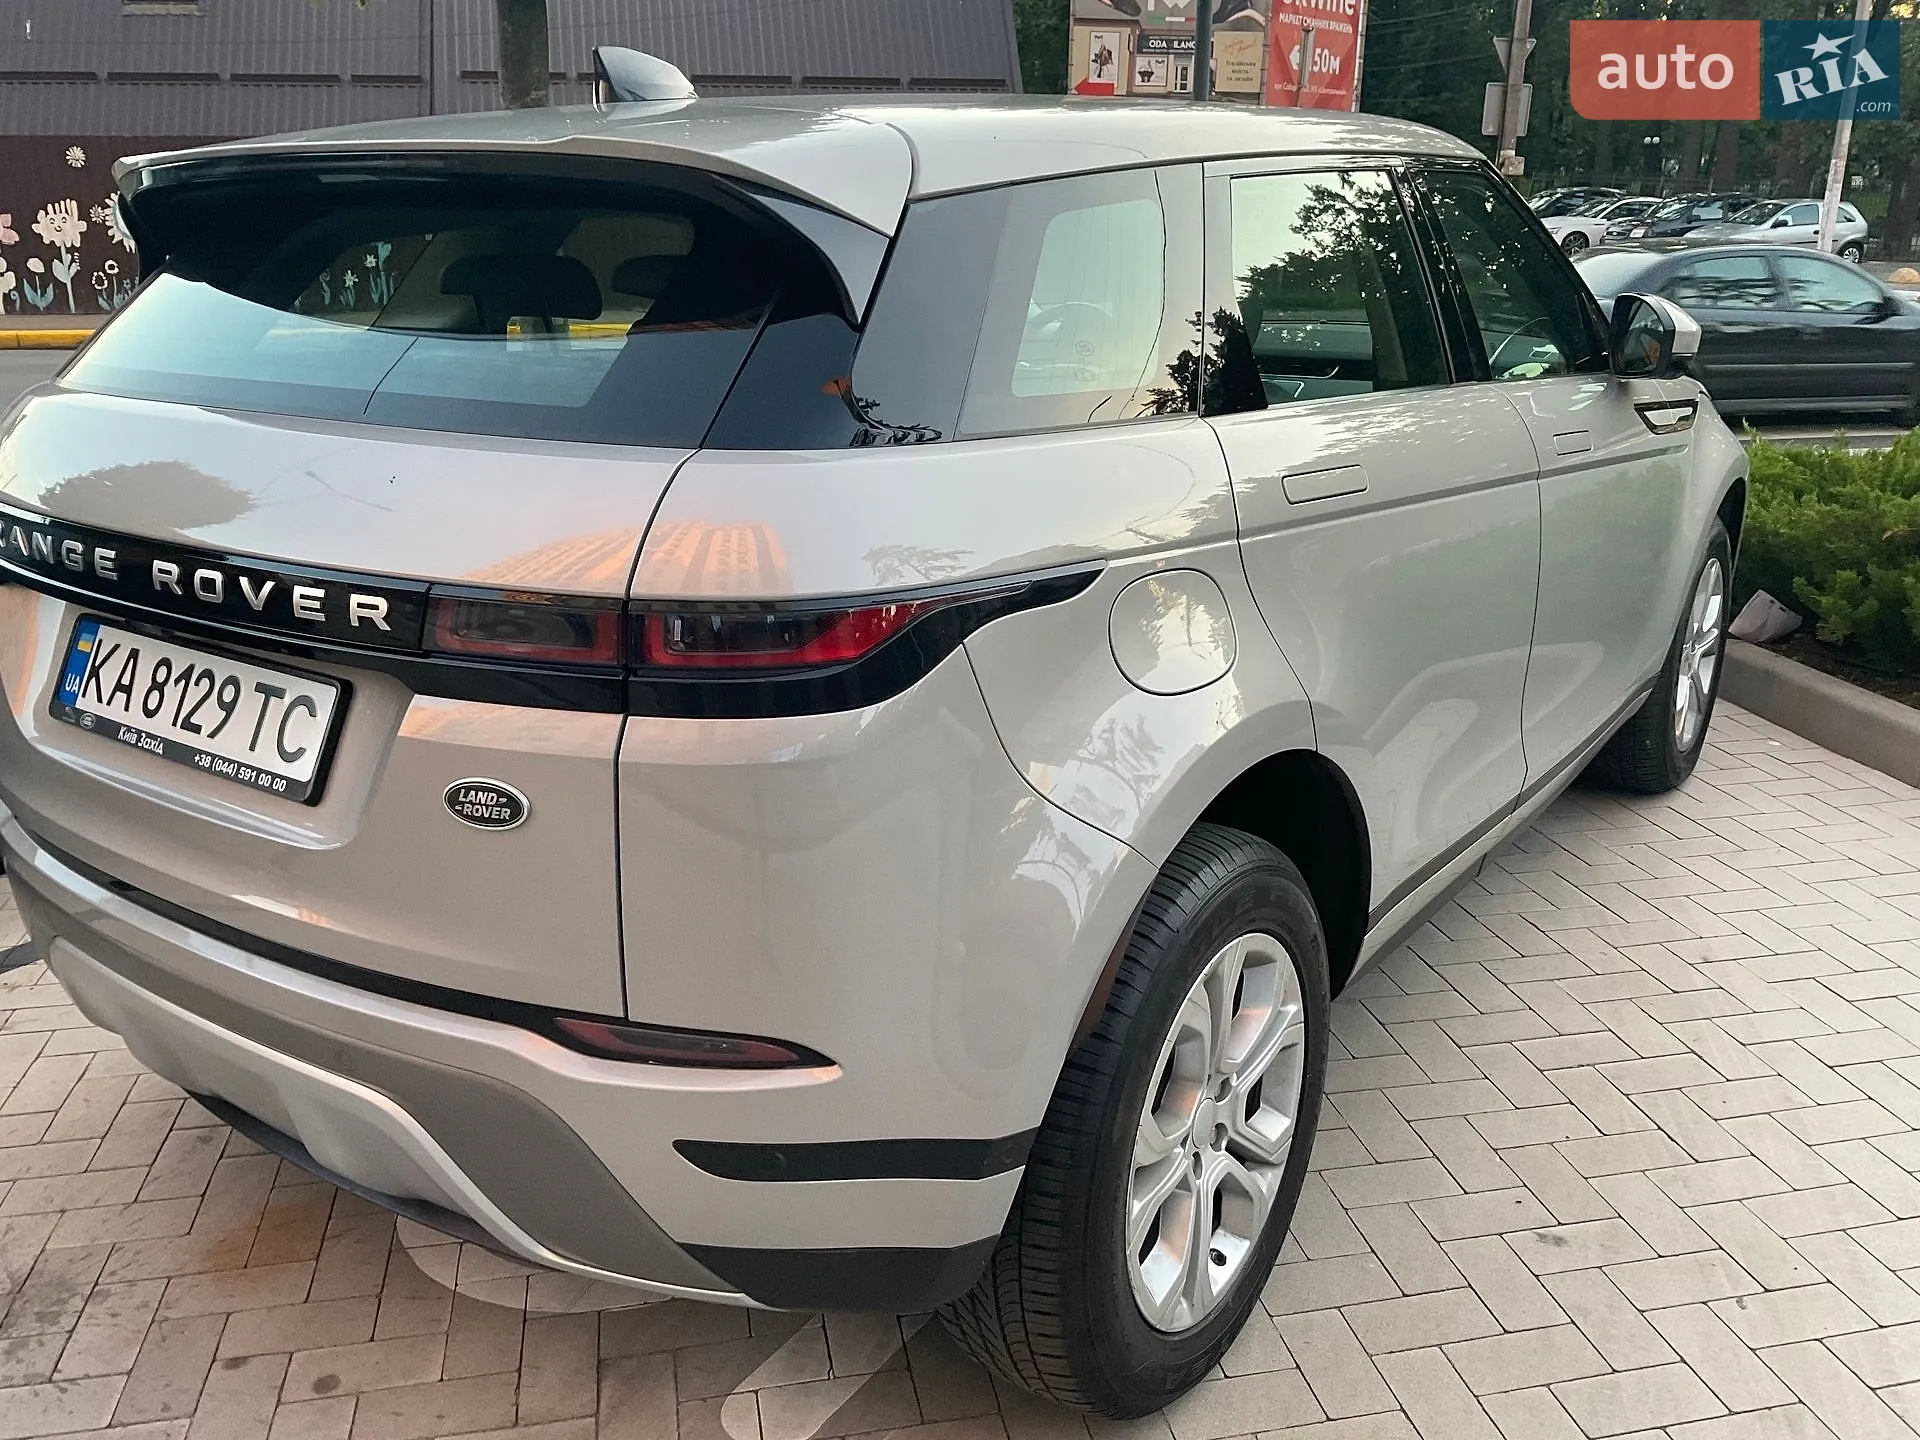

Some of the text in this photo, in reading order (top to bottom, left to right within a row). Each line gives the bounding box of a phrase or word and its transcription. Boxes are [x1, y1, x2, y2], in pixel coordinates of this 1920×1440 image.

[1279, 12, 1303, 26] МАРКЕТ
[0, 521, 391, 631] ANGE ROVER
[65, 673, 80, 694] UA
[82, 638, 317, 762] KA 8129 TC
[118, 726, 164, 755] Київ Захід
[194, 752, 287, 793] +38 (044) 591 00 00
[458, 788, 498, 805] LAND
[462, 803, 511, 820] ROVER
